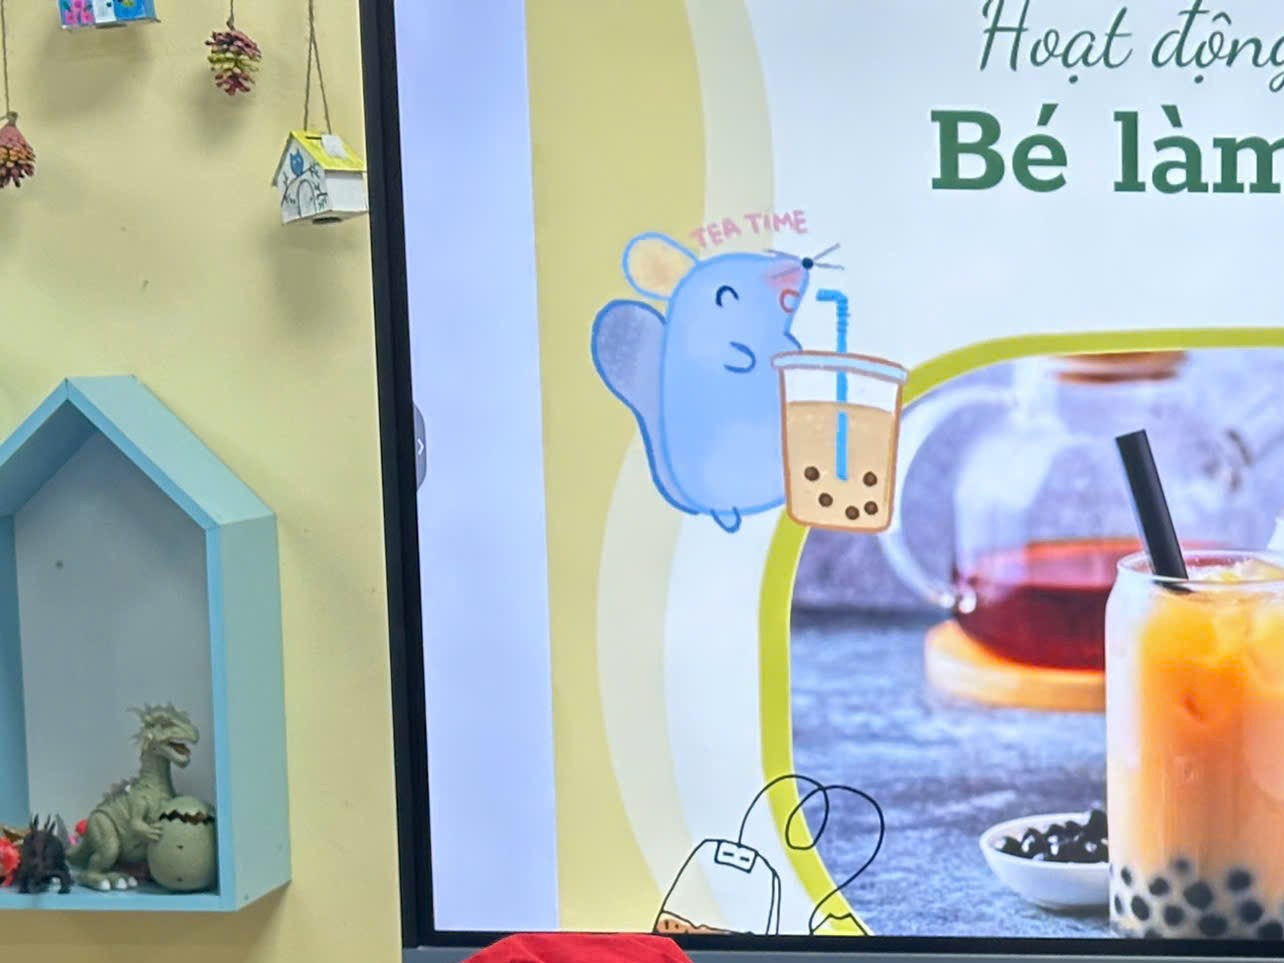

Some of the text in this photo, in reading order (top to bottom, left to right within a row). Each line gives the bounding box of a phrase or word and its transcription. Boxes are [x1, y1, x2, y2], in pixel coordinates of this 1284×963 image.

[979, 0, 1133, 84] Hoạt
[931, 103, 1067, 192] Bé
[690, 209, 808, 248] TEA TIME
